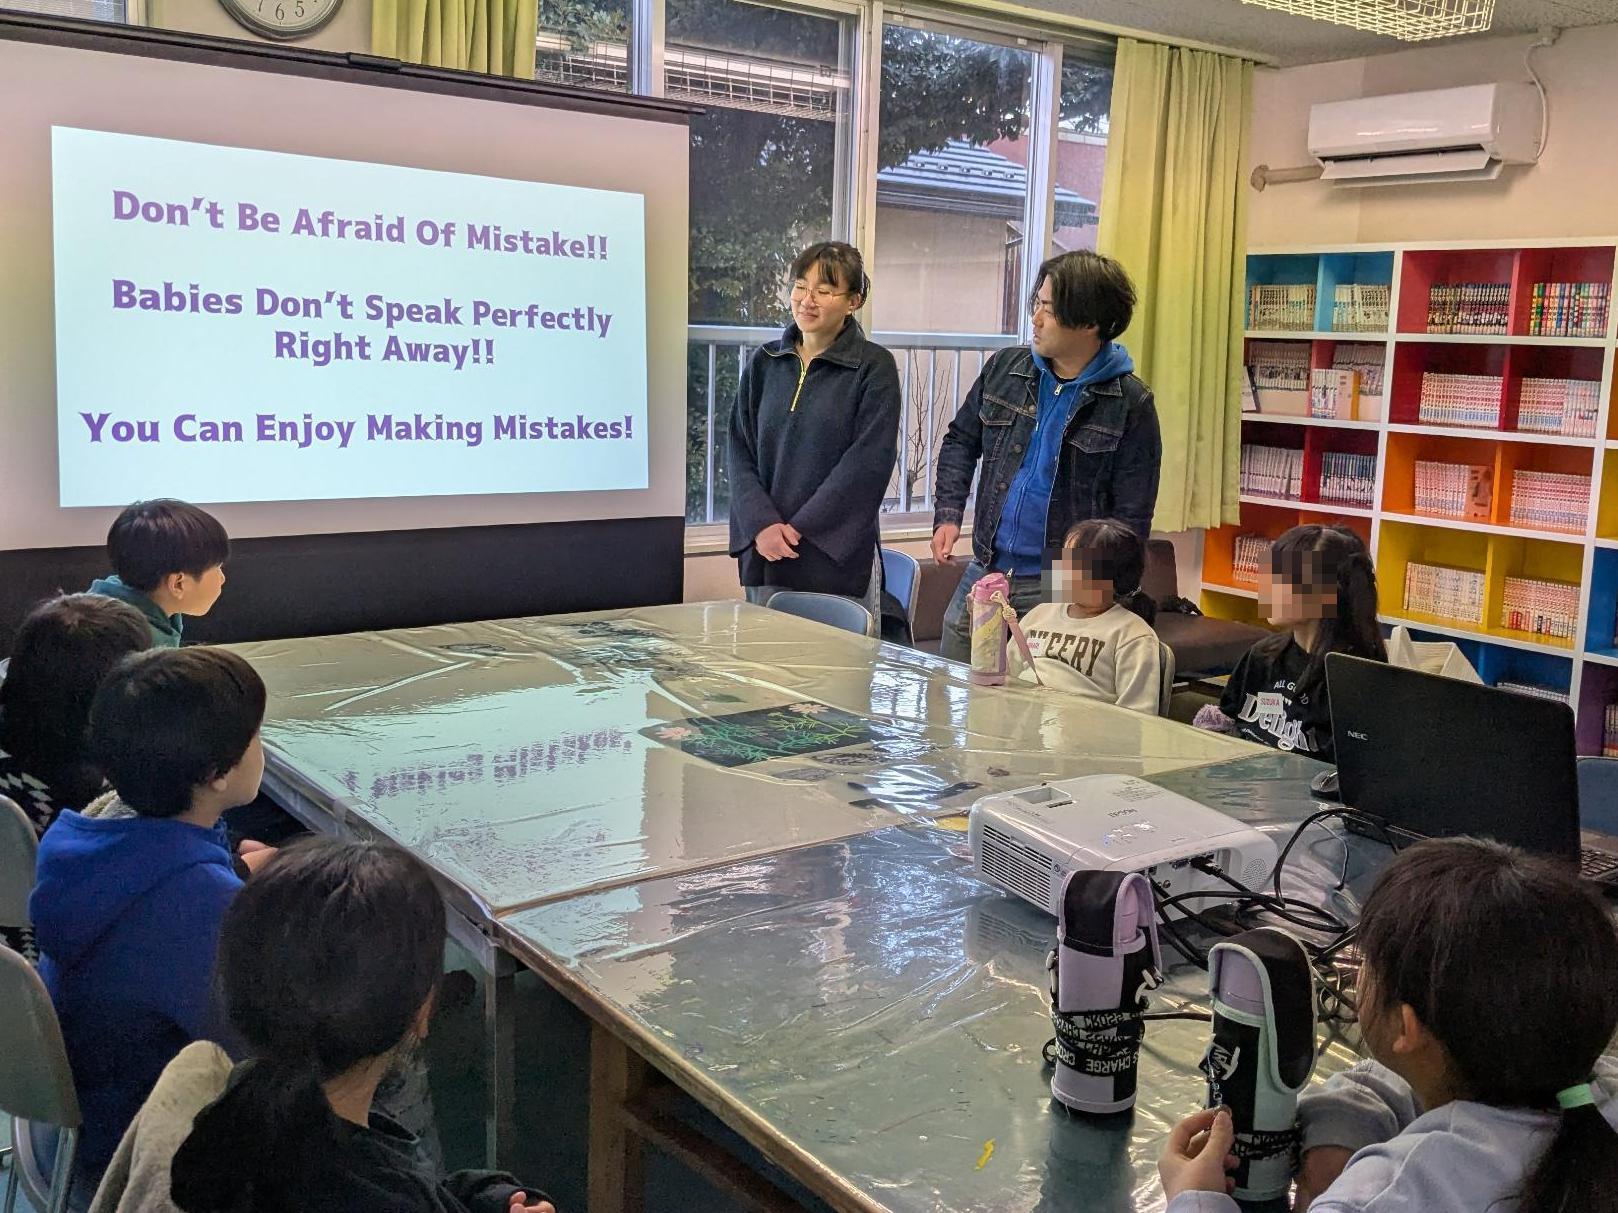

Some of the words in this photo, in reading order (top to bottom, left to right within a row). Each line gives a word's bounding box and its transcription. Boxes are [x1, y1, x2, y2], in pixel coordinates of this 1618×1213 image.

[275, 3, 285, 20] 6
[238, 203, 280, 233] Be
[292, 208, 406, 244] Afraid
[417, 221, 456, 248] Of
[467, 224, 608, 261] Mistake!!
[112, 280, 243, 315] Babies
[366, 295, 463, 325] Speak
[473, 301, 613, 338] Perfectly
[275, 331, 371, 366] Right
[382, 335, 495, 370] Away!!
[80, 413, 160, 443] You
[173, 414, 243, 443] Can
[256, 414, 356, 449] Enjoy
[368, 414, 483, 448] Making
[494, 415, 633, 441] Mistakes!
[1273, 680, 1285, 690] ALL
[1347, 730, 1368, 741] NEC
[1086, 1057, 1131, 1073] CHARGE
